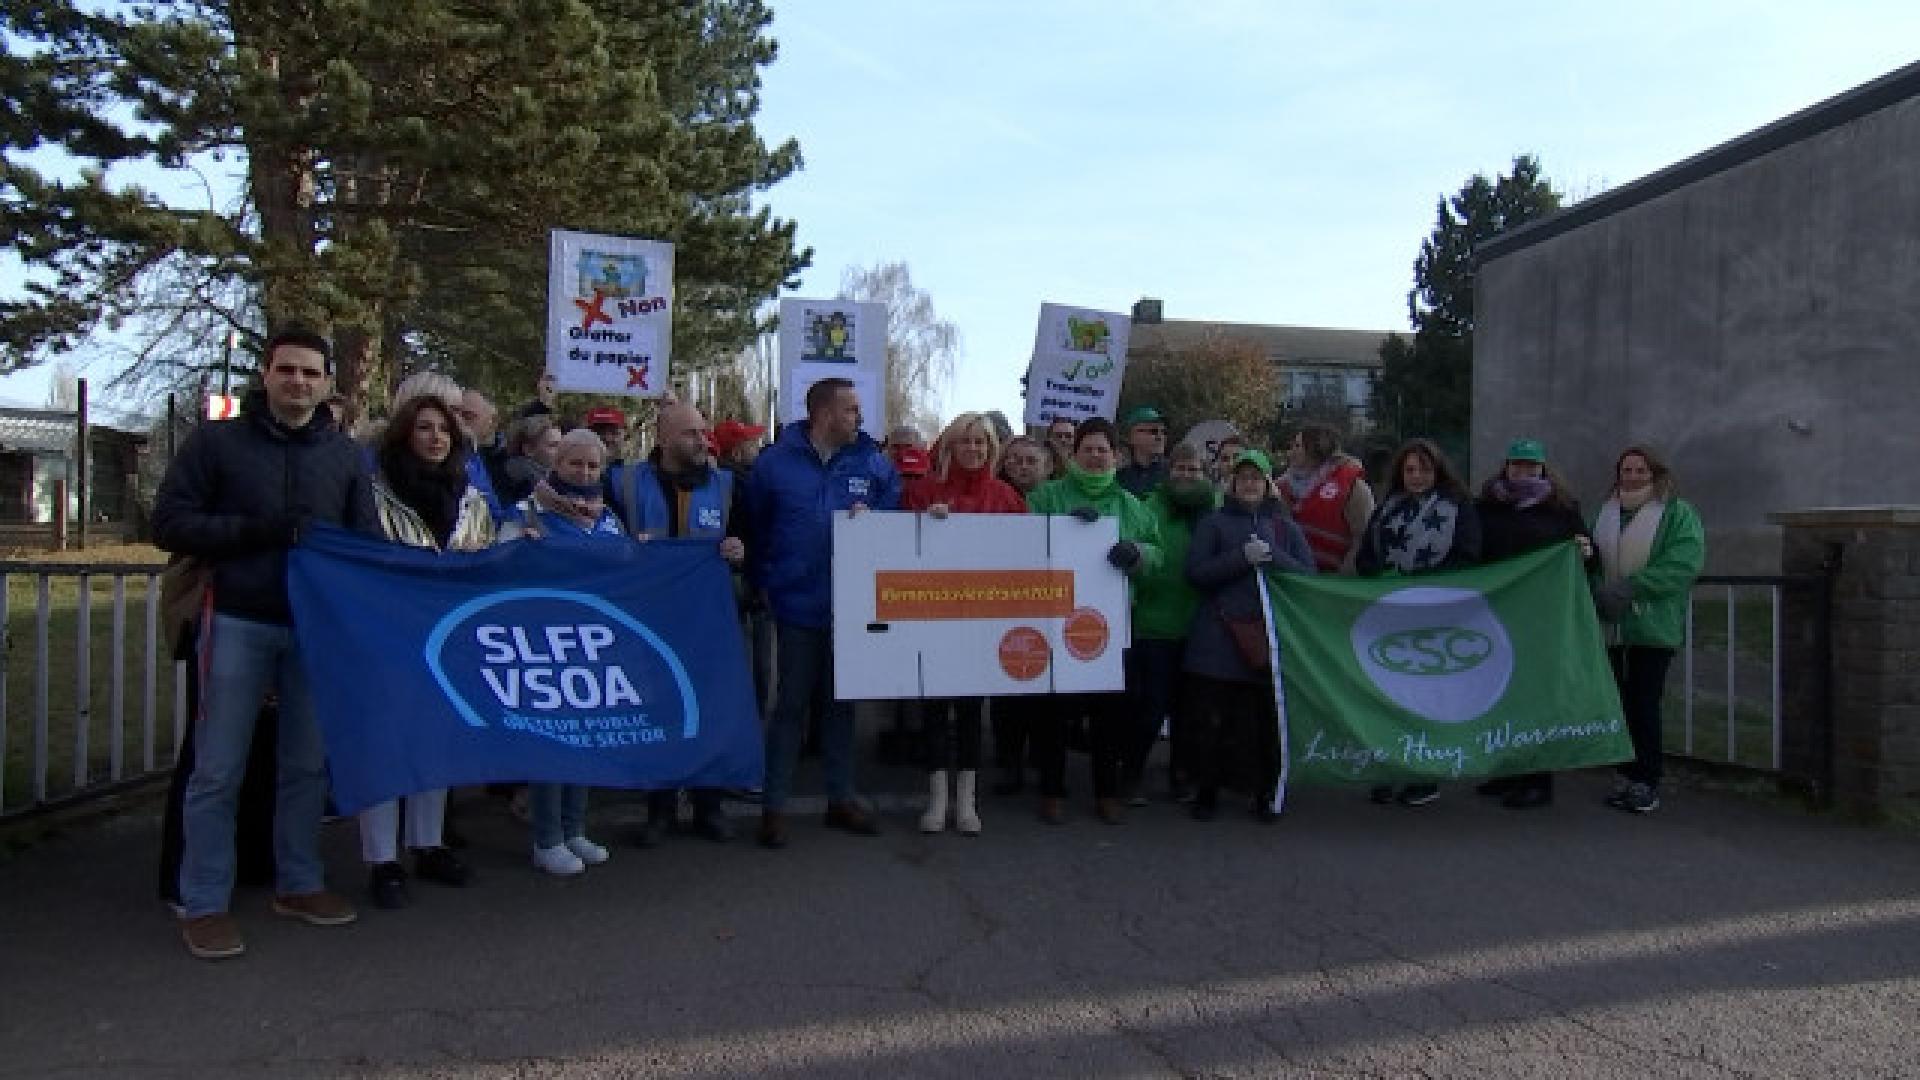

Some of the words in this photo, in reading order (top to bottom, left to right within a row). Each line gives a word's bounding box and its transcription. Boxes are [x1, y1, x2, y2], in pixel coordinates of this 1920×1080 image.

[617, 297, 667, 318] Non
[569, 346, 591, 361] du
[594, 350, 651, 366] papier
[476, 624, 615, 664] SLFP
[1374, 627, 1494, 675] CSC
[480, 664, 643, 709] VSOA
[584, 713, 650, 730] PUBLIC
[595, 727, 667, 748] SECTOR
[1399, 731, 1470, 777] Huy
[1476, 719, 1622, 753] Waremme
